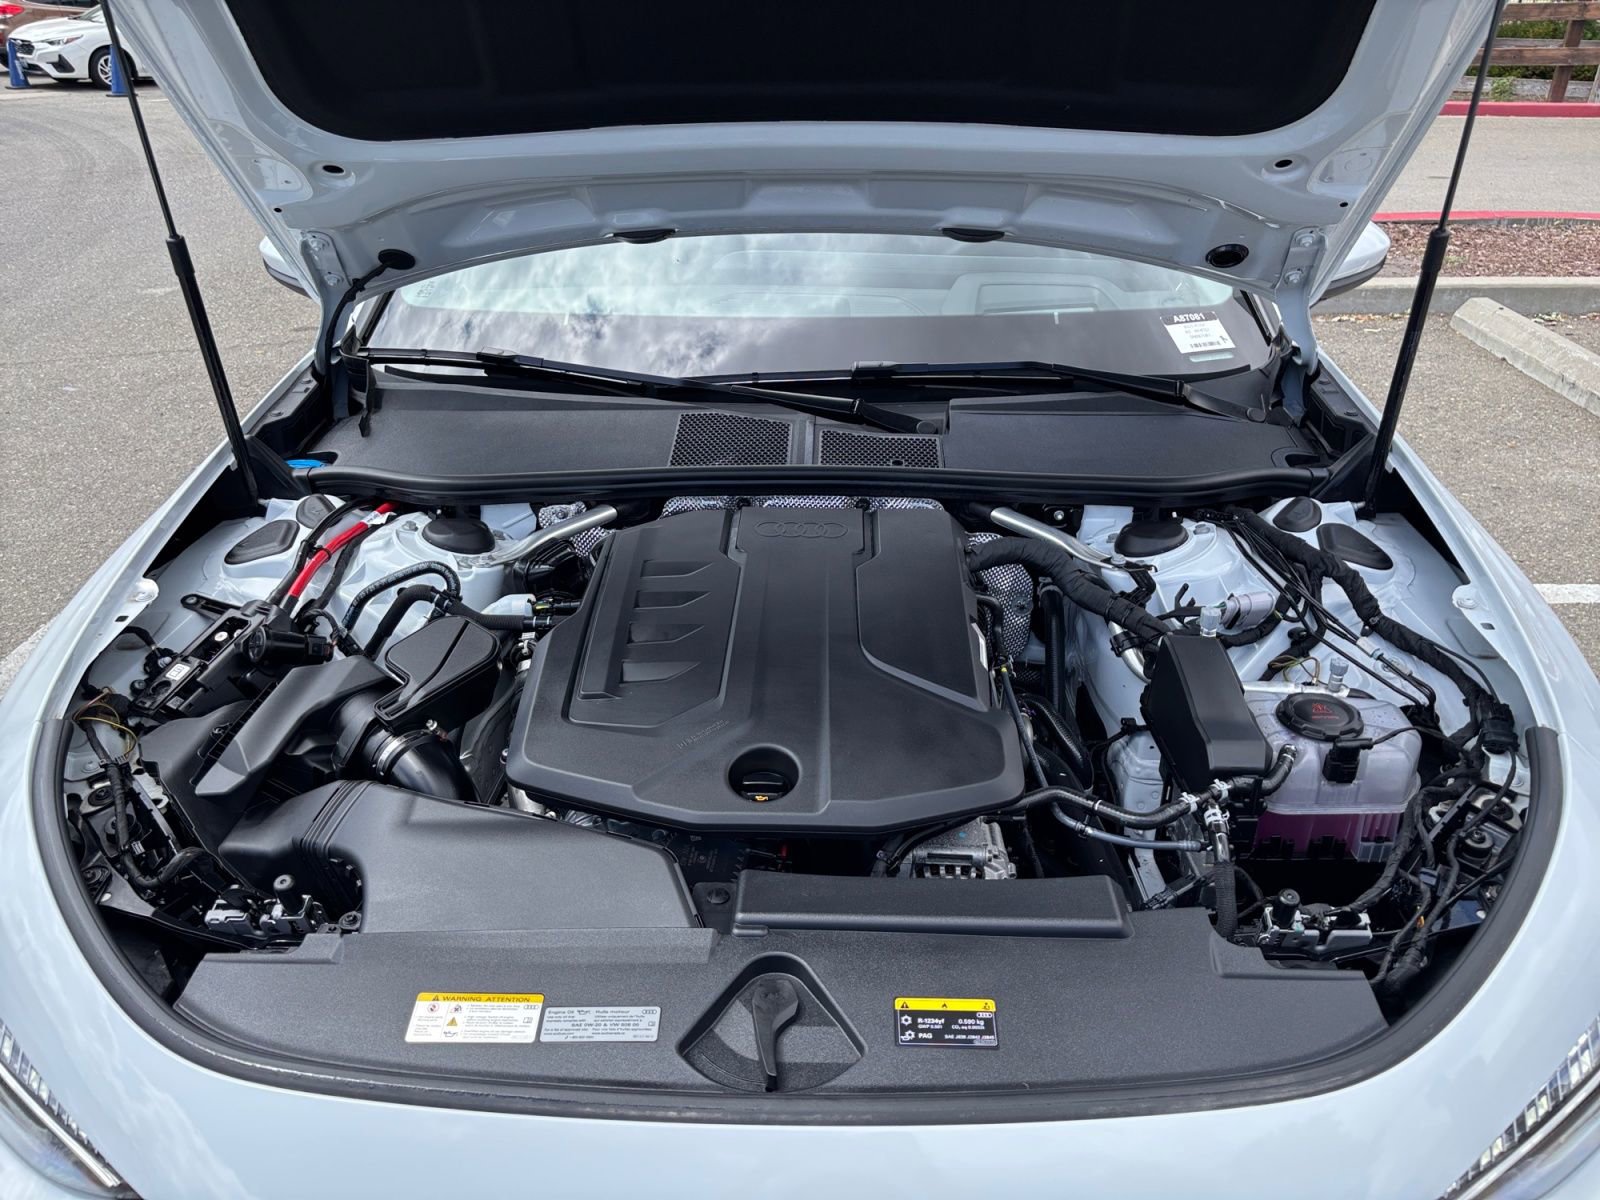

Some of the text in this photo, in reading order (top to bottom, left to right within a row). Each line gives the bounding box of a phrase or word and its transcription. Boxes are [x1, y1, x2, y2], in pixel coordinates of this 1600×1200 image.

[1173, 312, 1205, 323] A87081
[917, 1017, 945, 1025] R-1234yf
[976, 1018, 985, 1026] kg
